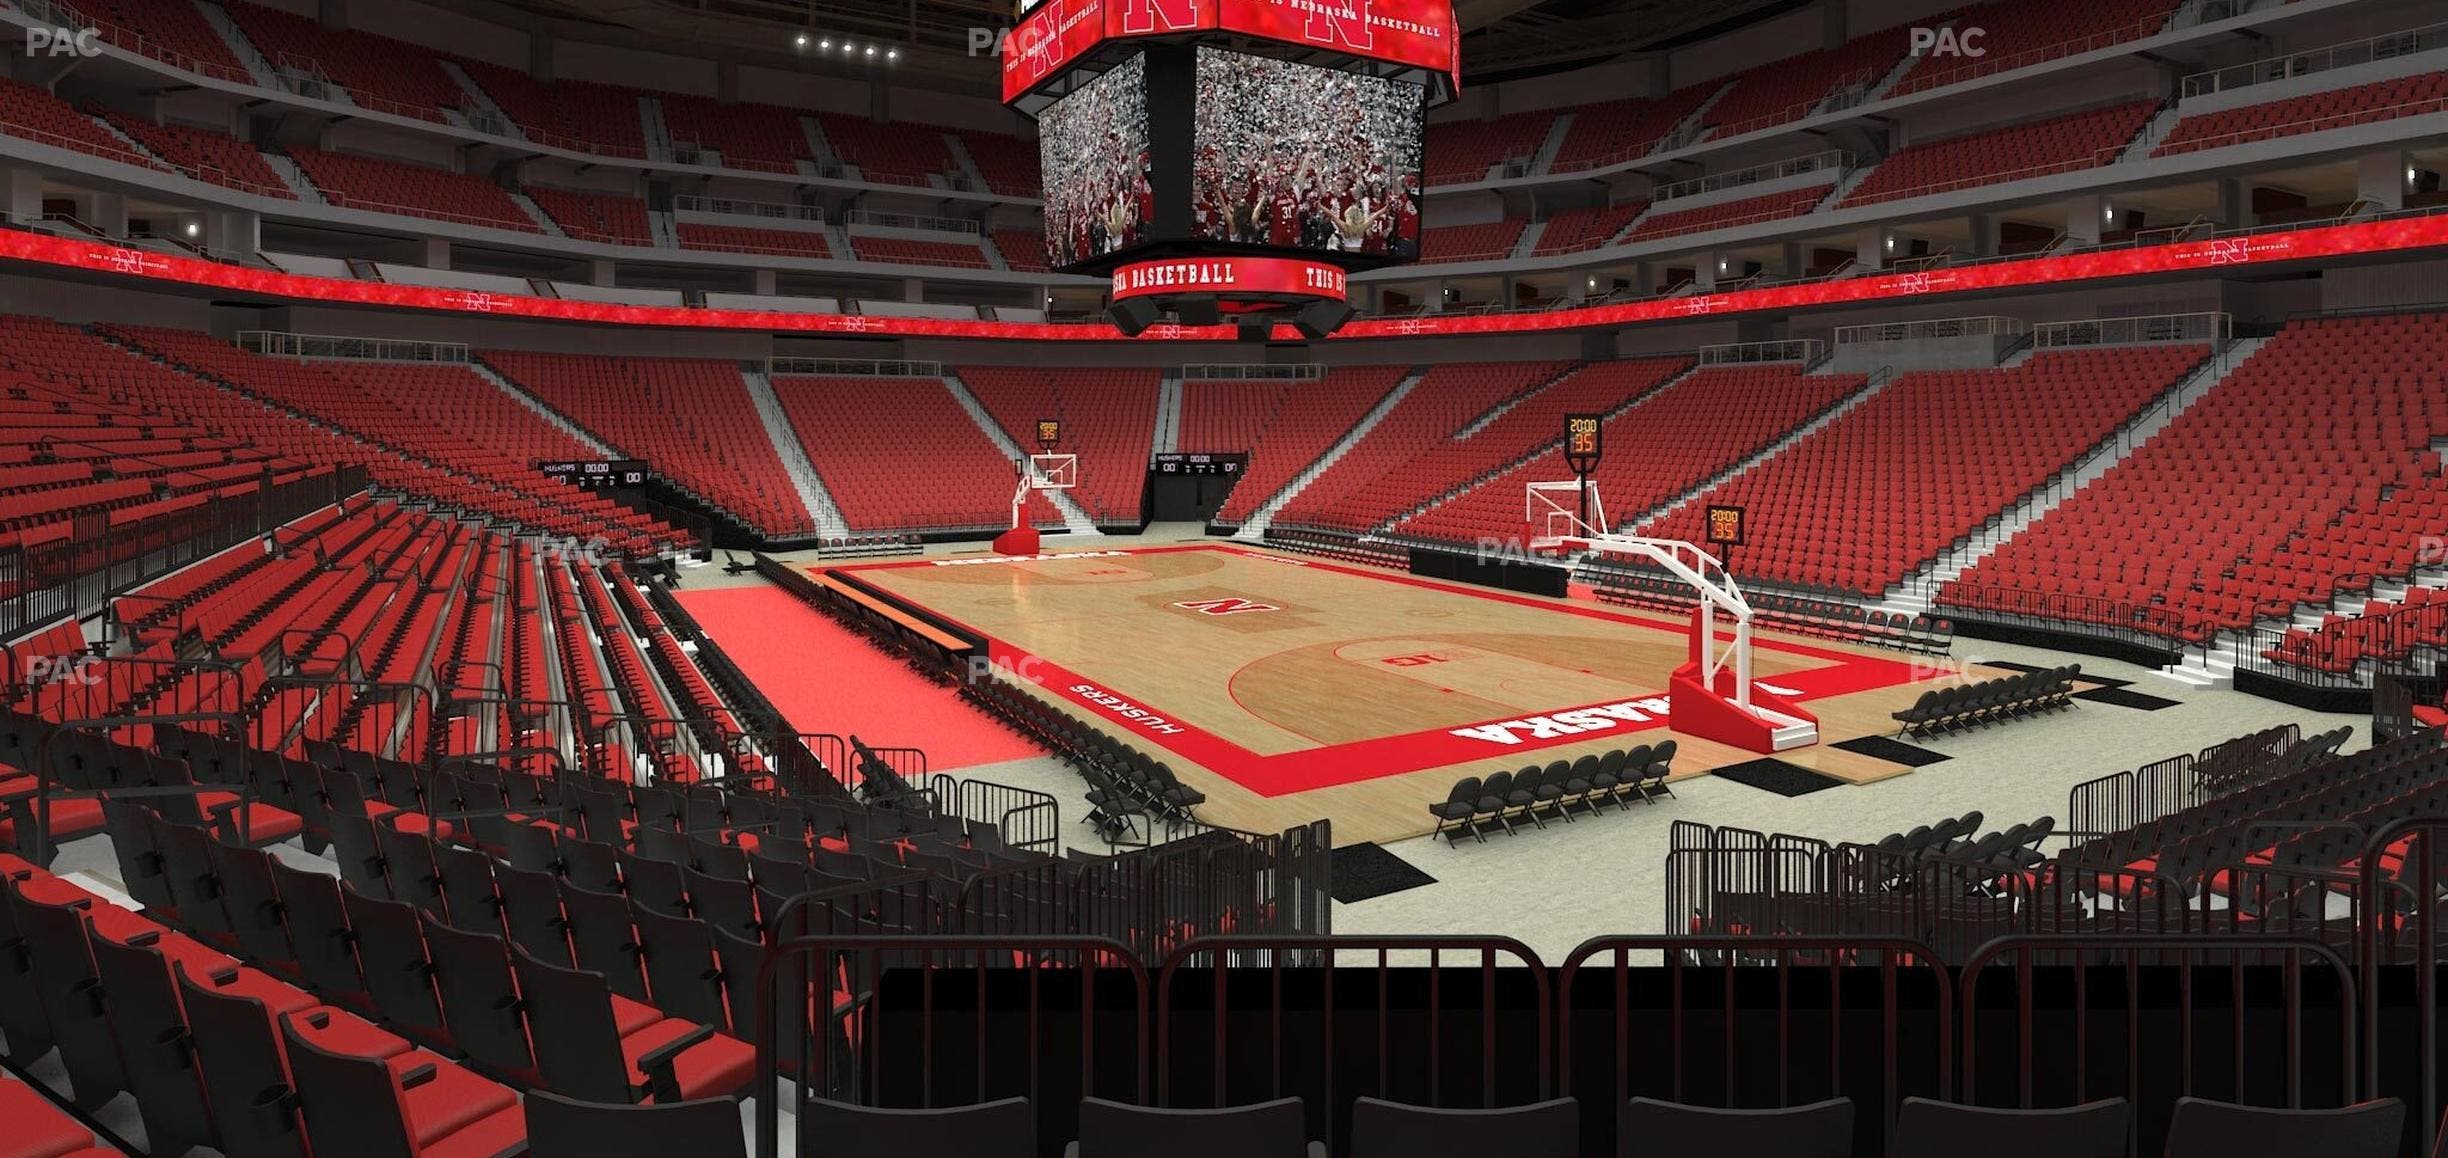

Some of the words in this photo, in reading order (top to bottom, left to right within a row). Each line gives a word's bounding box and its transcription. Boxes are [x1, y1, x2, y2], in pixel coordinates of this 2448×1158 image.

[1291, 0, 1357, 20] NEBRASKA
[1366, 14, 1441, 37] BASKETBALL
[1132, 263, 1235, 288] BASKETBALL
[1306, 267, 1333, 289] THIS
[1571, 419, 1597, 432] 20:00
[1576, 433, 1592, 451] 35
[585, 464, 609, 472] 00:00
[626, 473, 641, 483] 00
[1711, 510, 1738, 523] 20:00
[1716, 522, 1734, 539] 35
[1069, 684, 1185, 734] HUSKERS
